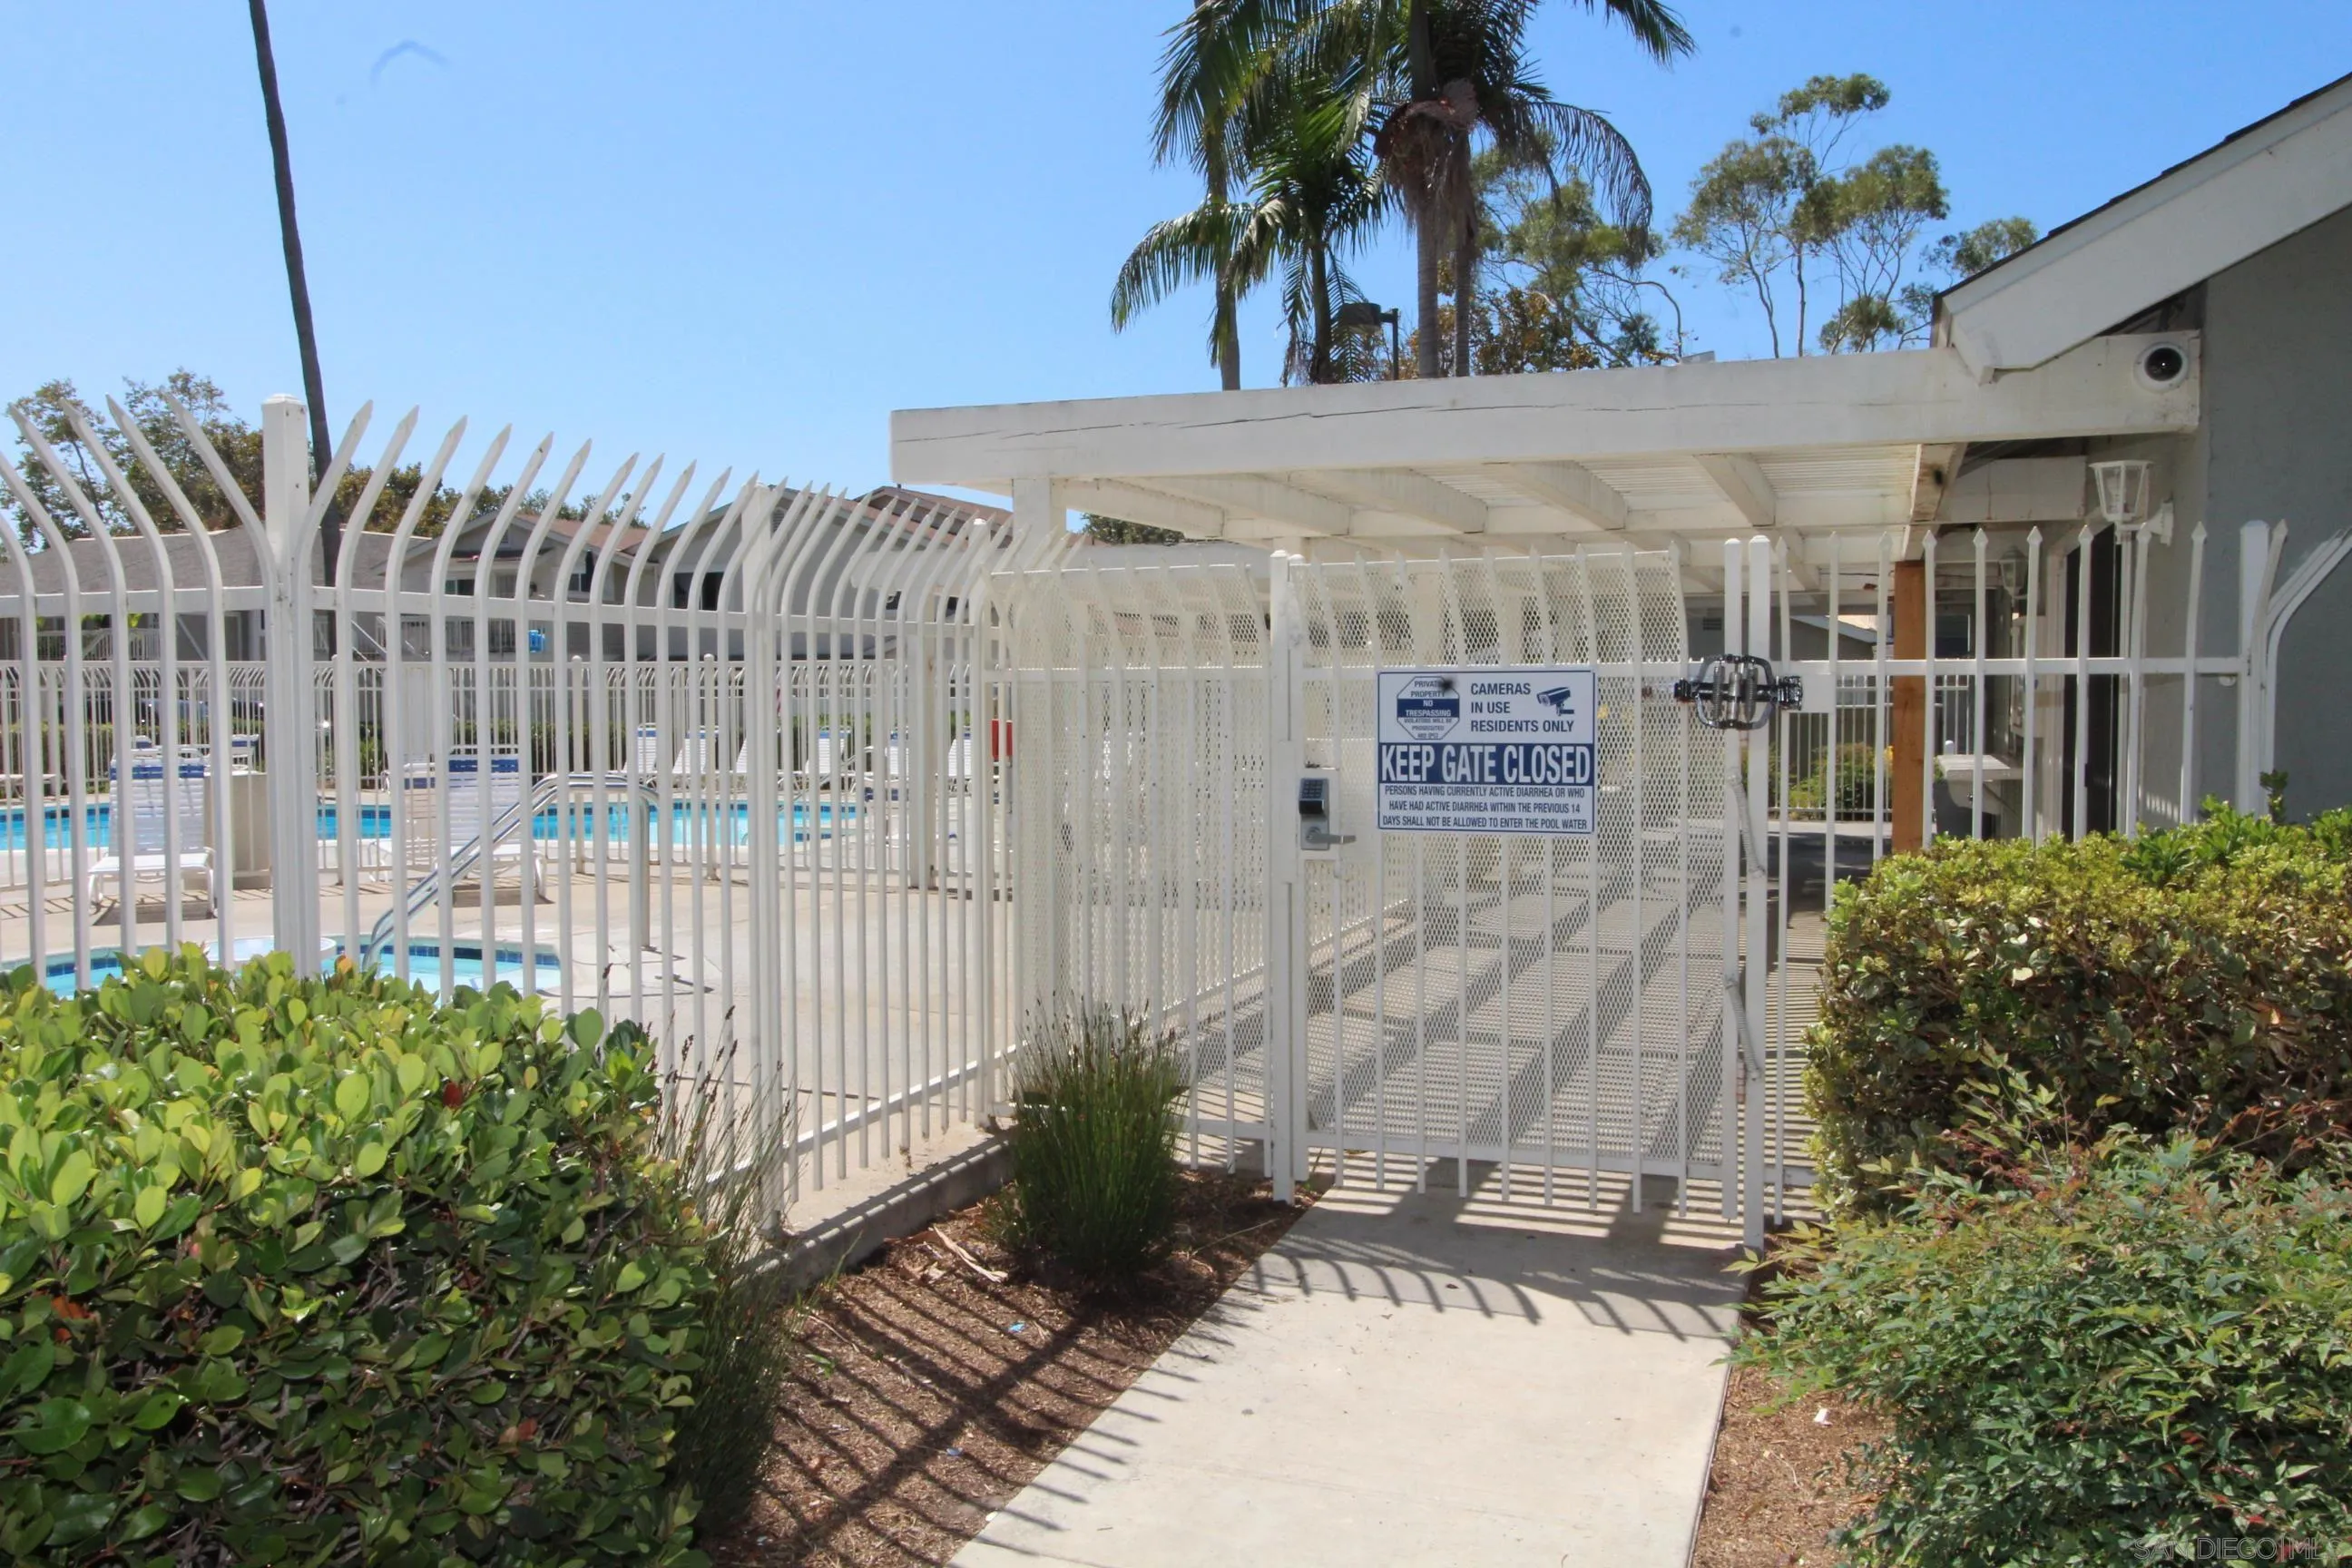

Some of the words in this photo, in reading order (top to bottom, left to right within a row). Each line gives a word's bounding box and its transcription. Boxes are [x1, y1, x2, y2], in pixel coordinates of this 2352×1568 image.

[1471, 683, 1531, 695] CAMERAS
[1471, 703, 1483, 714] IN
[1487, 702, 1511, 714] USE
[1470, 720, 1539, 732] RESIDENTS
[1543, 720, 1574, 733] ONLY
[1381, 745, 1436, 782] KEEP
[1441, 745, 1497, 782] GATE
[1503, 745, 1591, 784] CLOSED
[1385, 785, 1417, 796] PERSONS
[1418, 786, 1446, 796] HAVING
[1446, 786, 1487, 797] CURRENTLY
[1489, 787, 1514, 798] ACTIVE
[1516, 788, 1553, 798] DIARRHEA
[1554, 788, 1565, 798] OR
[1567, 788, 1585, 798] WHO
[1389, 800, 1407, 810] HAVE
[1409, 800, 1424, 810] HAD
[1426, 801, 1451, 811] ACTIVE
[1452, 801, 1488, 812] DIARRHEA
[1490, 802, 1515, 812] WITHIN
[1518, 802, 1532, 813] THE
[1534, 803, 1569, 813] PREVIOUS
[1572, 804, 1581, 813] 14
[1383, 816, 1401, 825] DAYS
[1402, 816, 1424, 826] SHALL
[1426, 817, 1440, 826] NOT
[1442, 817, 1451, 827] BE
[1453, 817, 1487, 828] ALLOWED
[1489, 818, 1498, 828] TO
[1500, 818, 1524, 828] ENTER
[1524, 818, 1539, 828] THE
[1541, 818, 1560, 828] POOL
[1562, 819, 1587, 829] WATER
